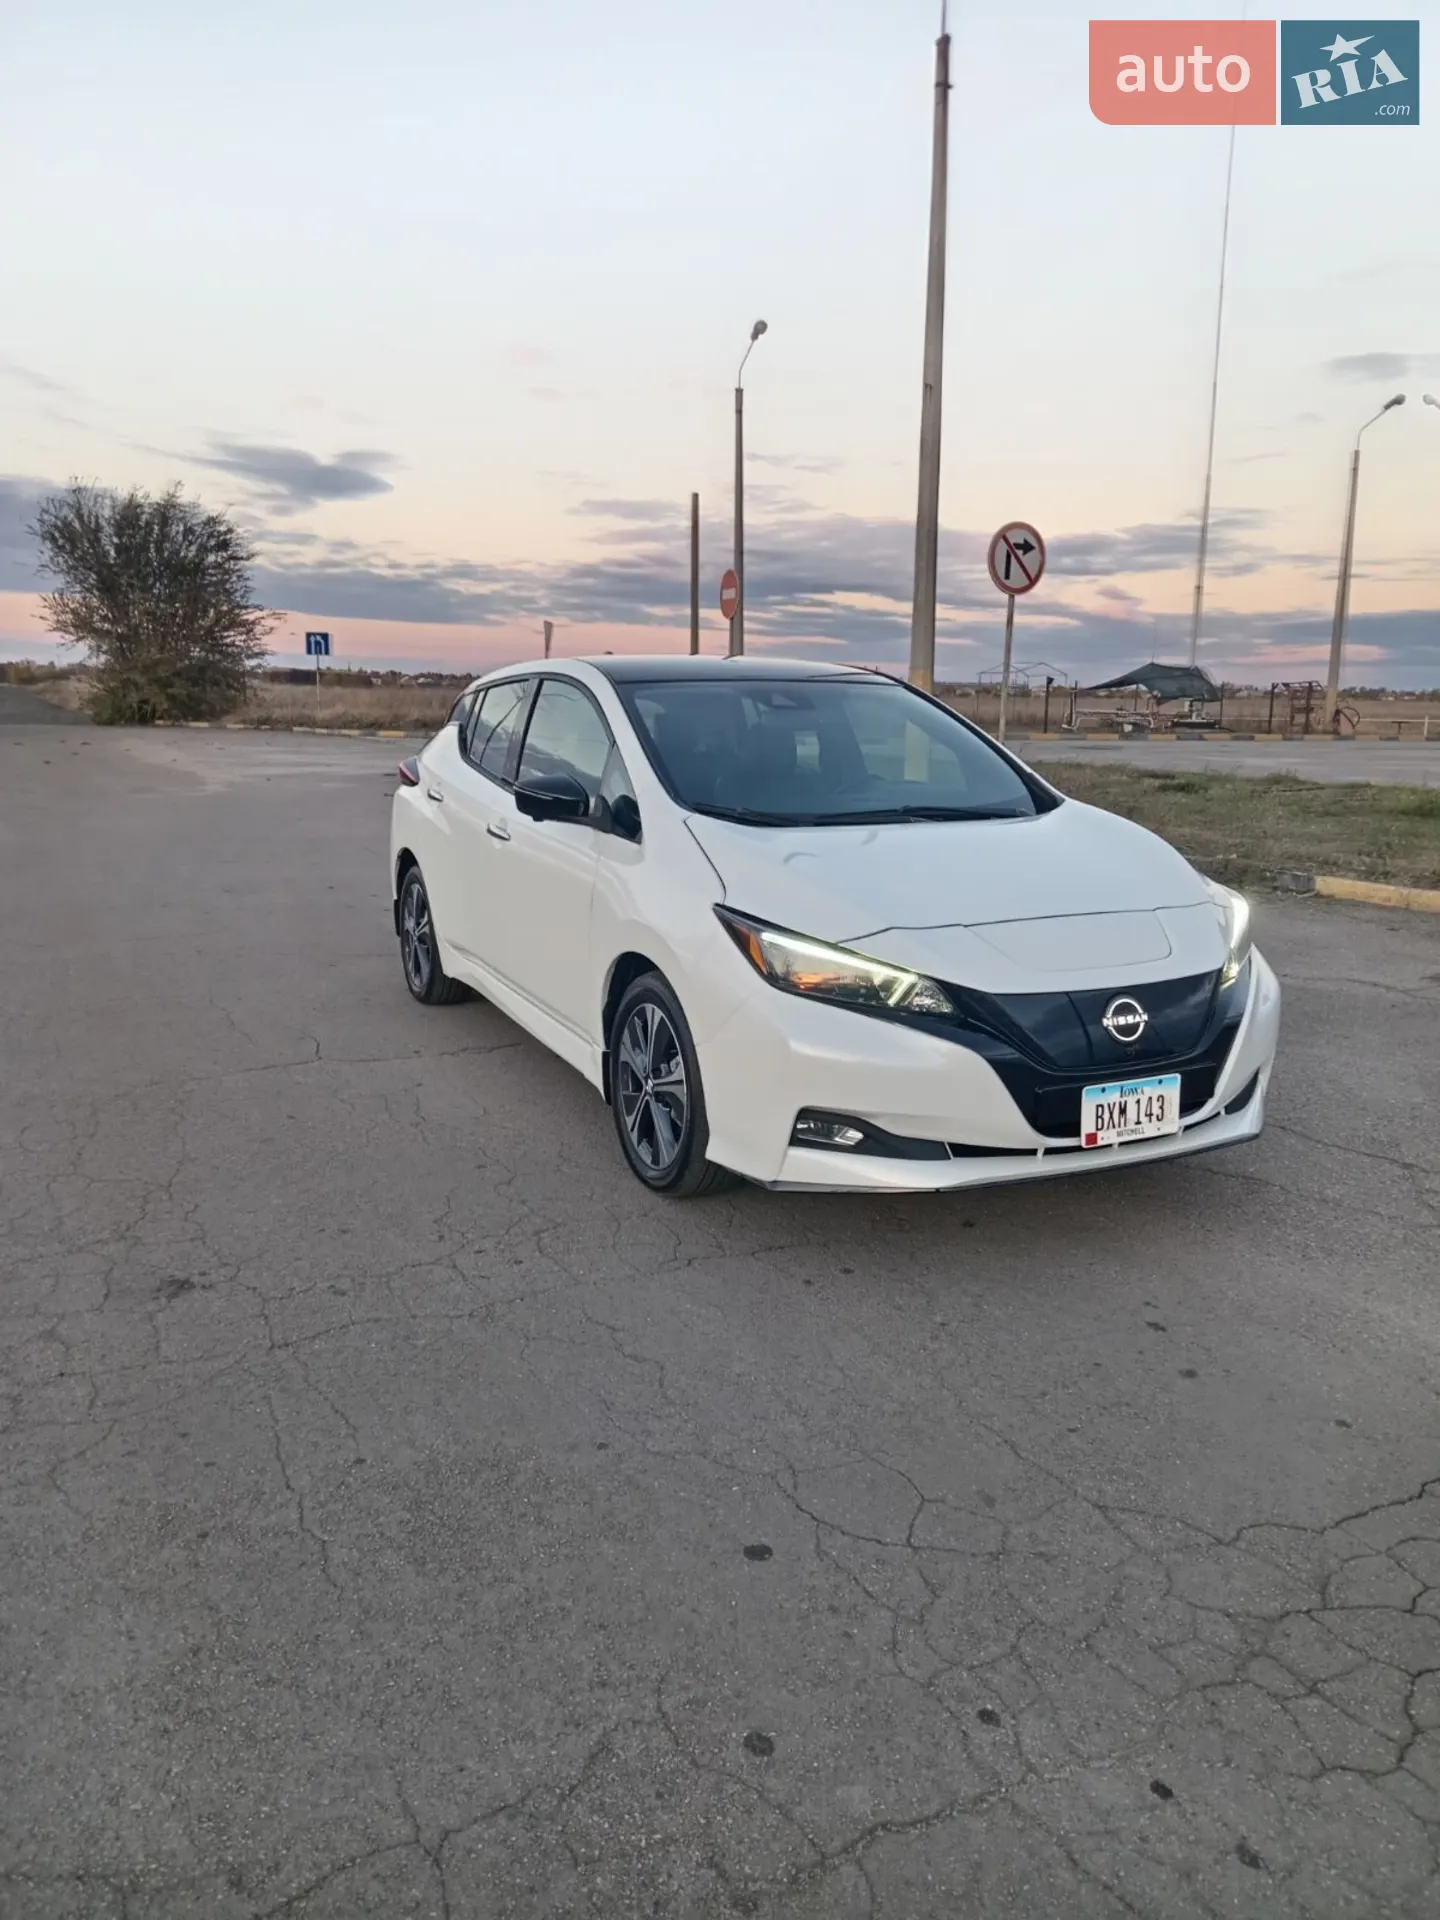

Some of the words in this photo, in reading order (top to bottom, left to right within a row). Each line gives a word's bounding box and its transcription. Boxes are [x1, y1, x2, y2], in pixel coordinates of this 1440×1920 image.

[1102, 1012, 1148, 1027] NISSAN
[1095, 1100, 1127, 1132] BXM
[1134, 1094, 1165, 1125] 143
